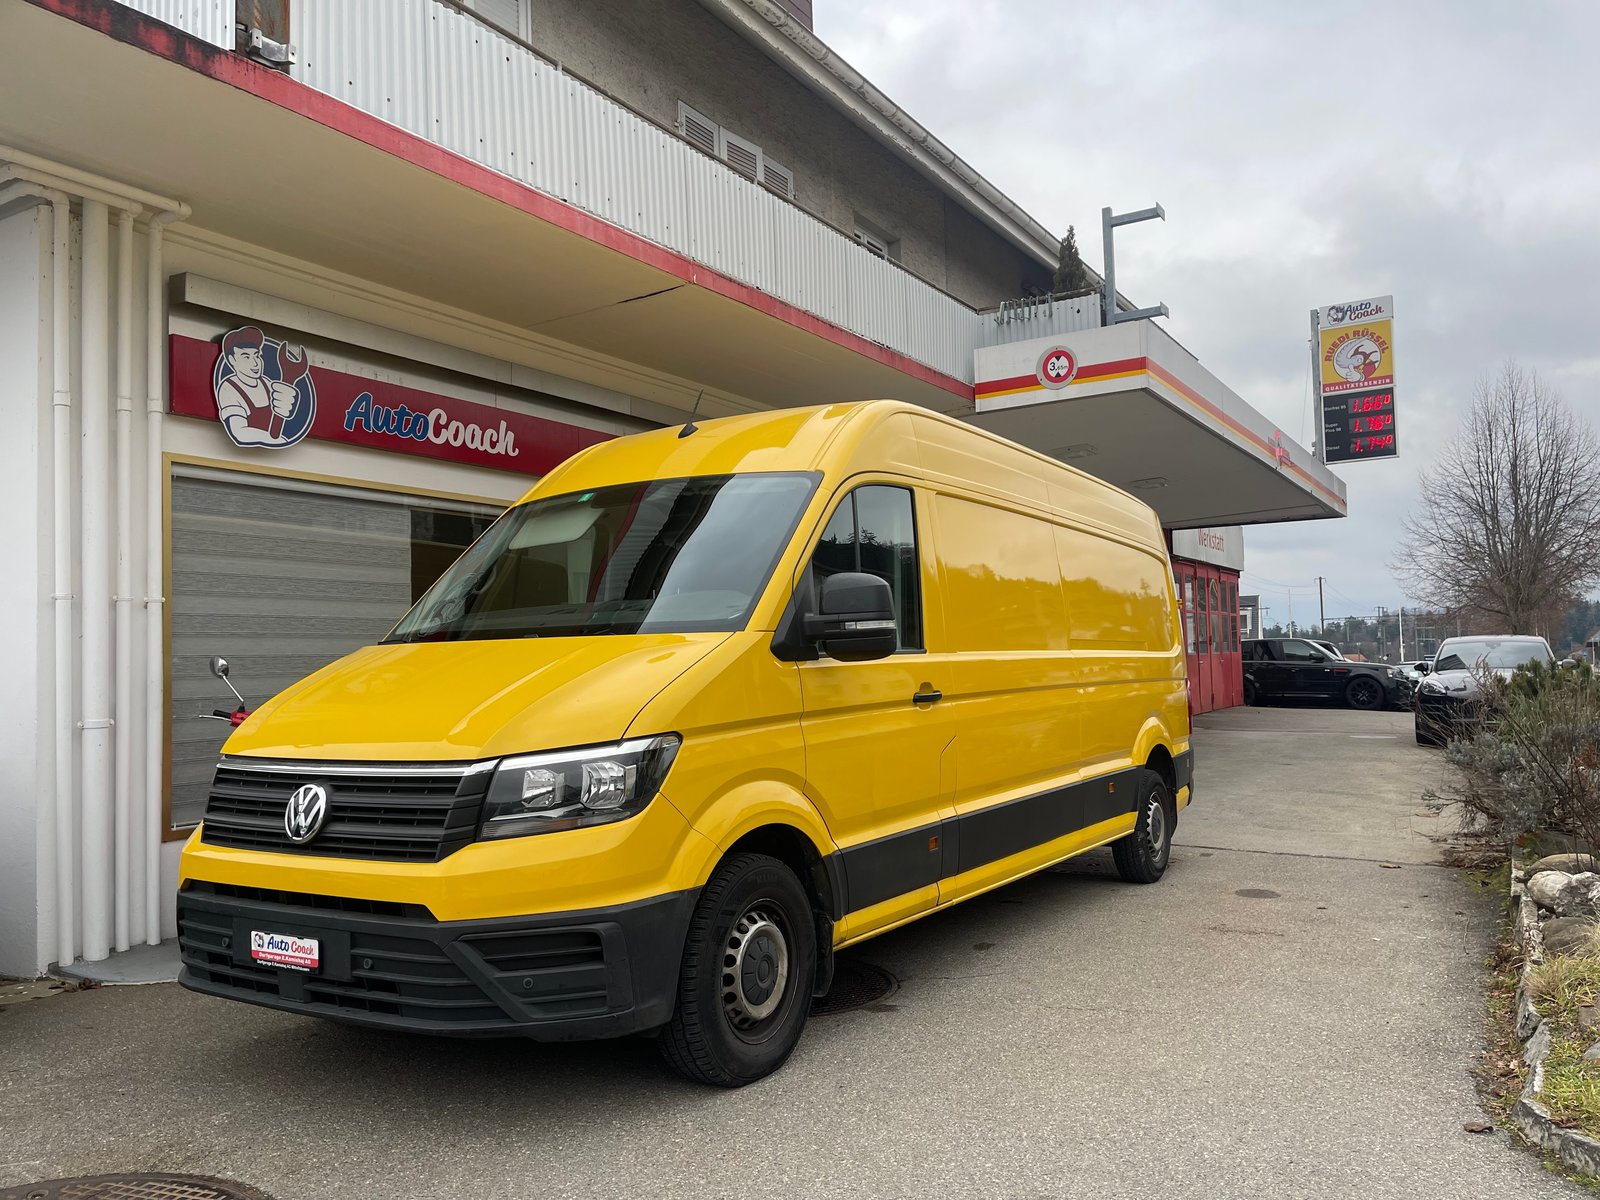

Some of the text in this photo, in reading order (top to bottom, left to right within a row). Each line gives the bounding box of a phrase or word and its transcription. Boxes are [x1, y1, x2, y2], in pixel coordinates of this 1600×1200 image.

[1345, 302, 1371, 315] Auto
[1350, 305, 1384, 321] Coach
[1325, 328, 1389, 362] RUEDI RÜSSEL
[1198, 528, 1225, 552] Werkstatt
[267, 935, 314, 956] Auto Coach
